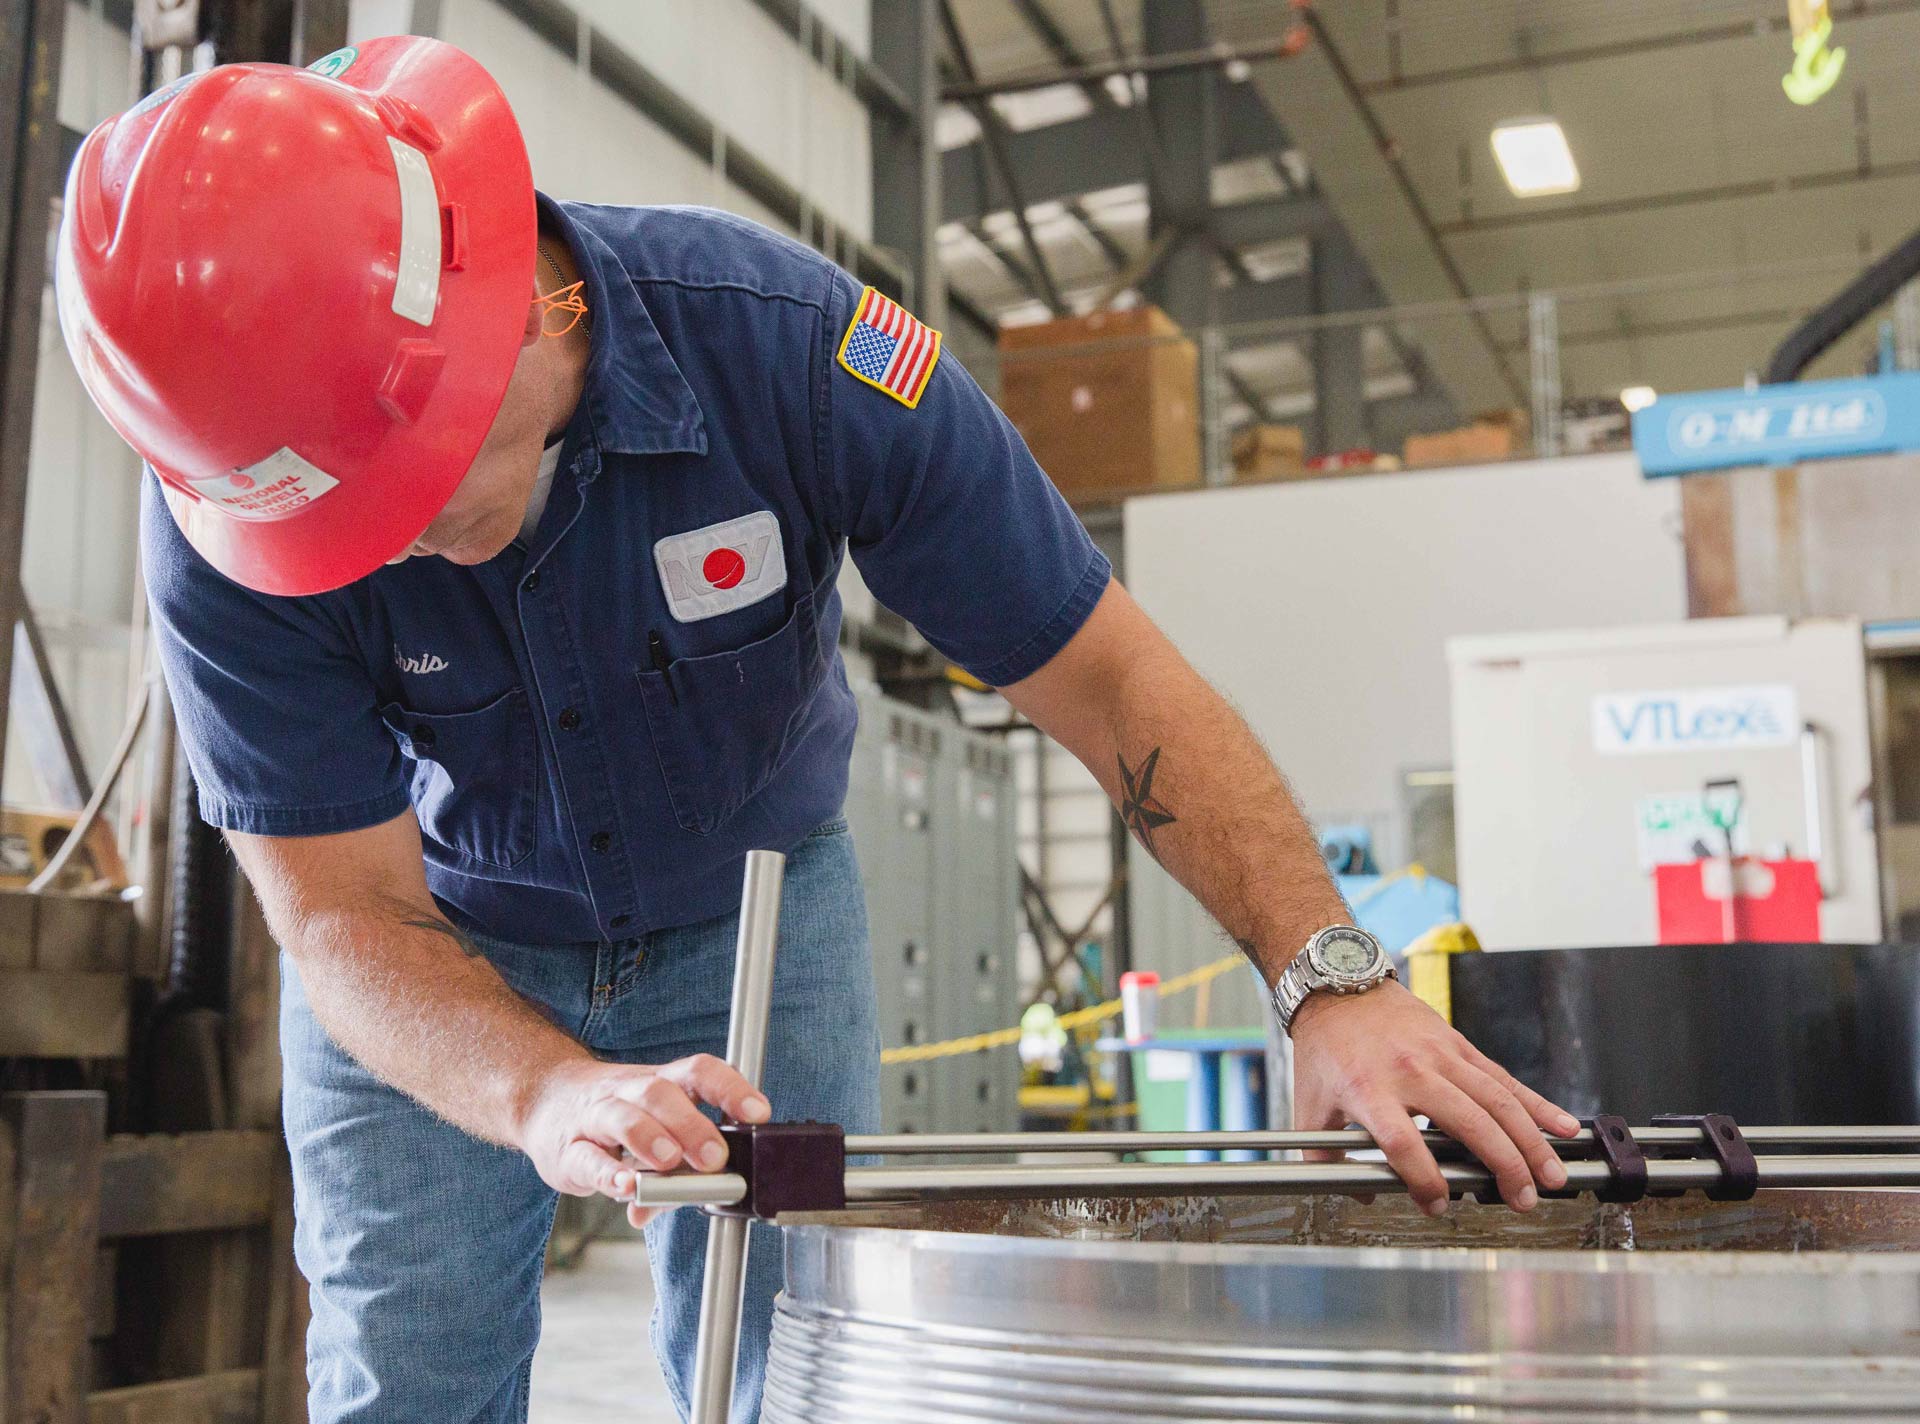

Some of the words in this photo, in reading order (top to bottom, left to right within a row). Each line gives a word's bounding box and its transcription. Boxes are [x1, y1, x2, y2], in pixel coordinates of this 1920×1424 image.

[221, 475, 301, 504] NATIONAL
[239, 486, 307, 511] OILWELL
[257, 495, 310, 514] VARCO
[394, 643, 449, 674] hris
